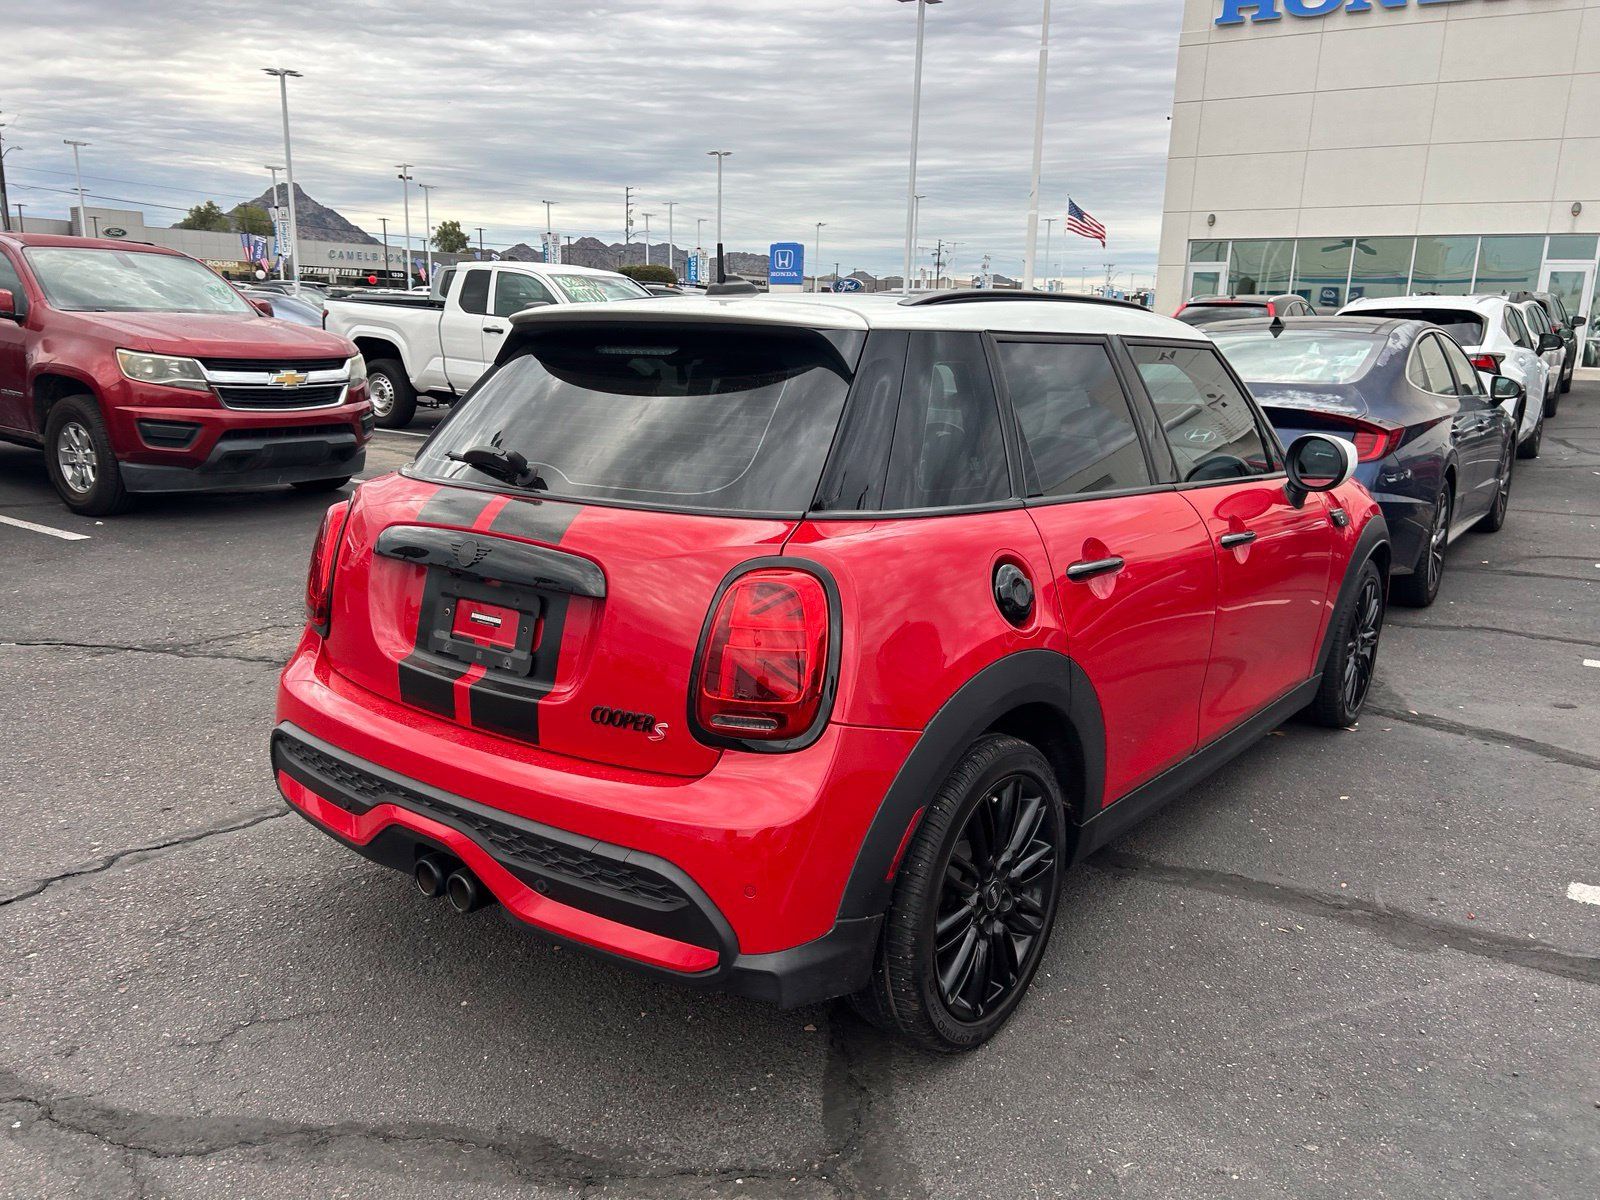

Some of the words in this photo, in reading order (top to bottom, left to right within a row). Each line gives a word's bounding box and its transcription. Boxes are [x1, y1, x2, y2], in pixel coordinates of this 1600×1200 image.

[328, 249, 402, 263] CAMELBACK
[206, 260, 239, 268] ROUSH
[299, 266, 340, 276] CEPTAMOS
[590, 705, 656, 733] COOPER
[647, 722, 669, 742] S
